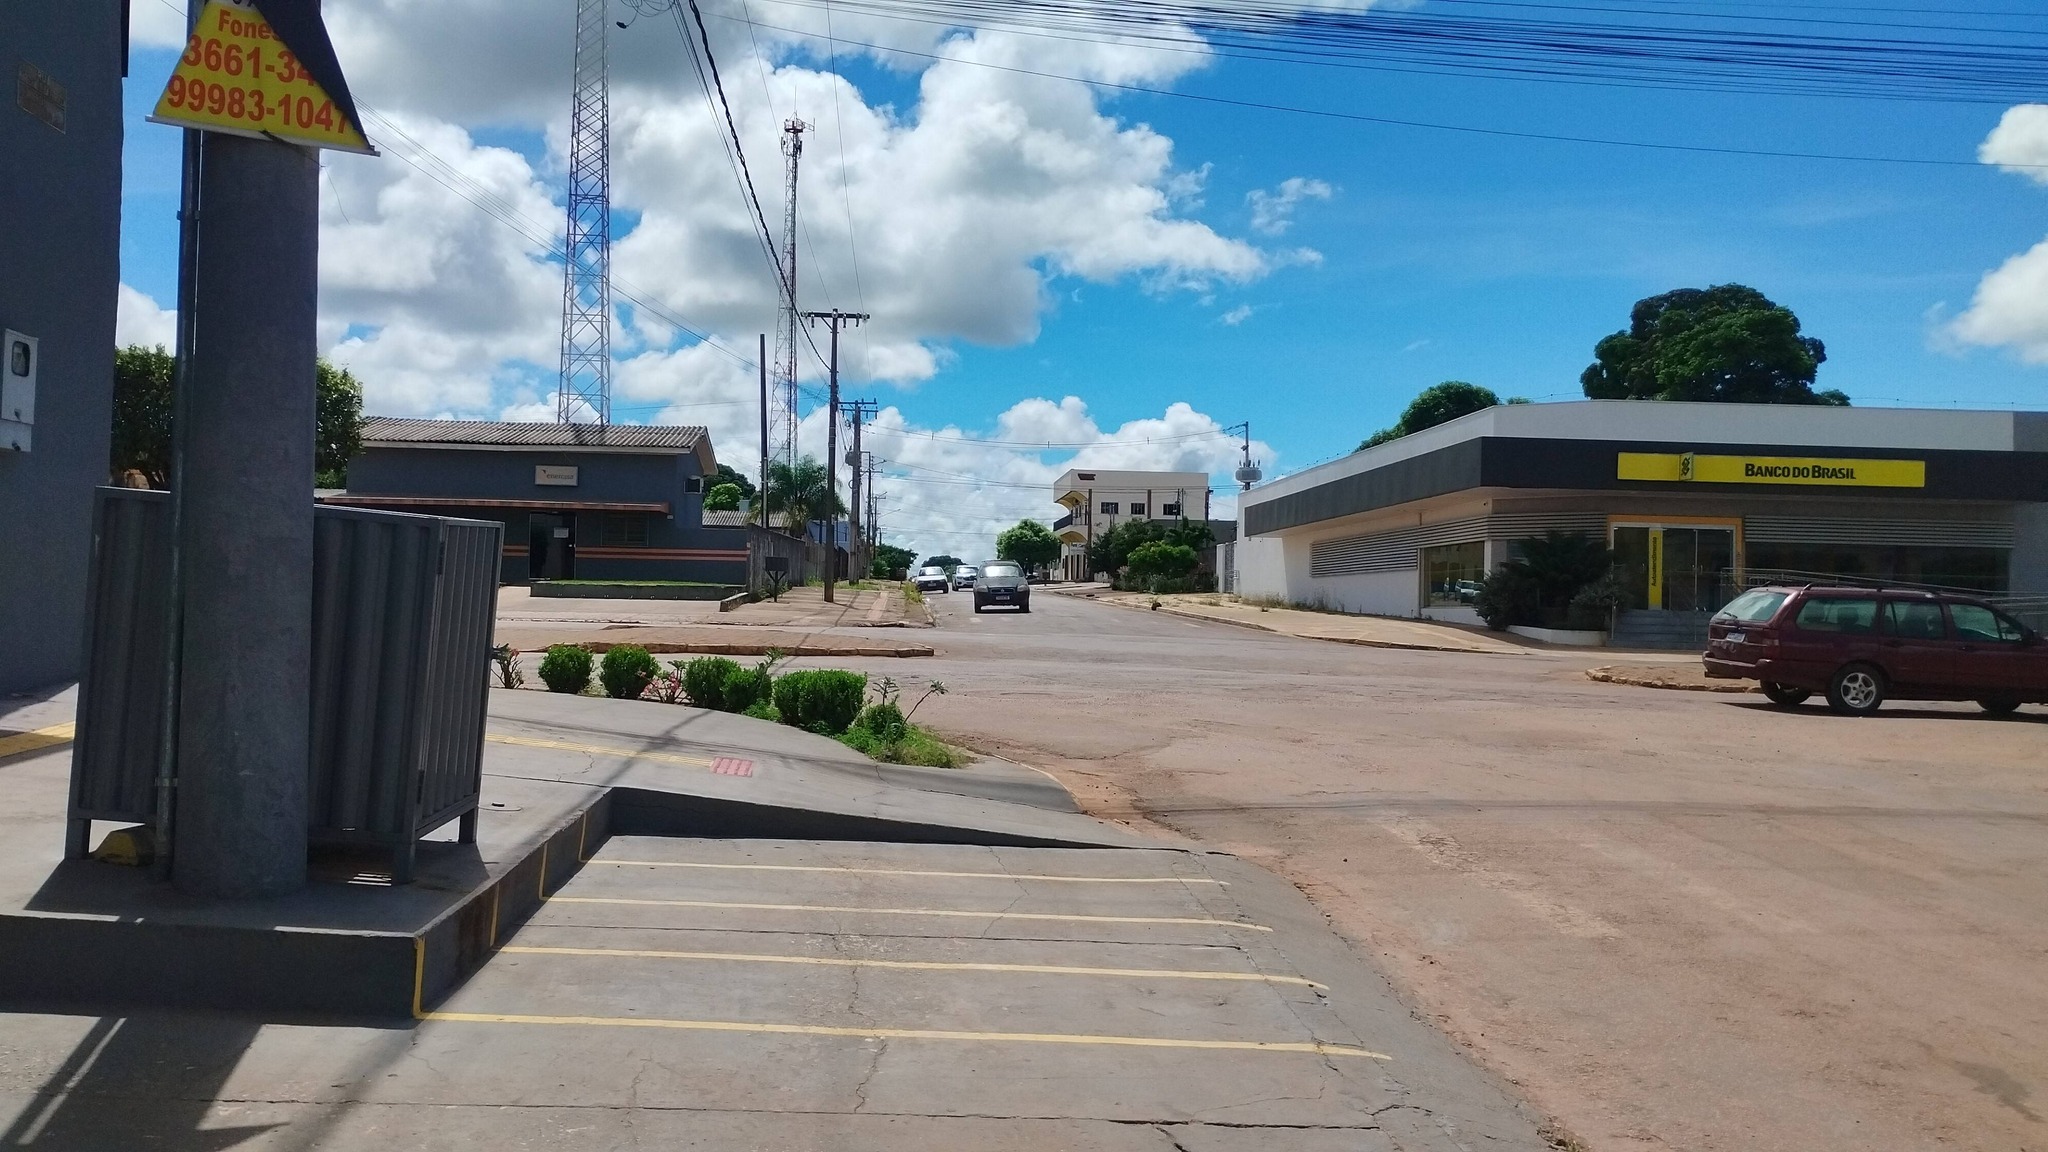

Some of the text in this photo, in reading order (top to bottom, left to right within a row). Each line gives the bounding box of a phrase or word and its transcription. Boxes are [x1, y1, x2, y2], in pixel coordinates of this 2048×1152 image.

[1745, 463, 1857, 479] BANCO DO BRASIL
